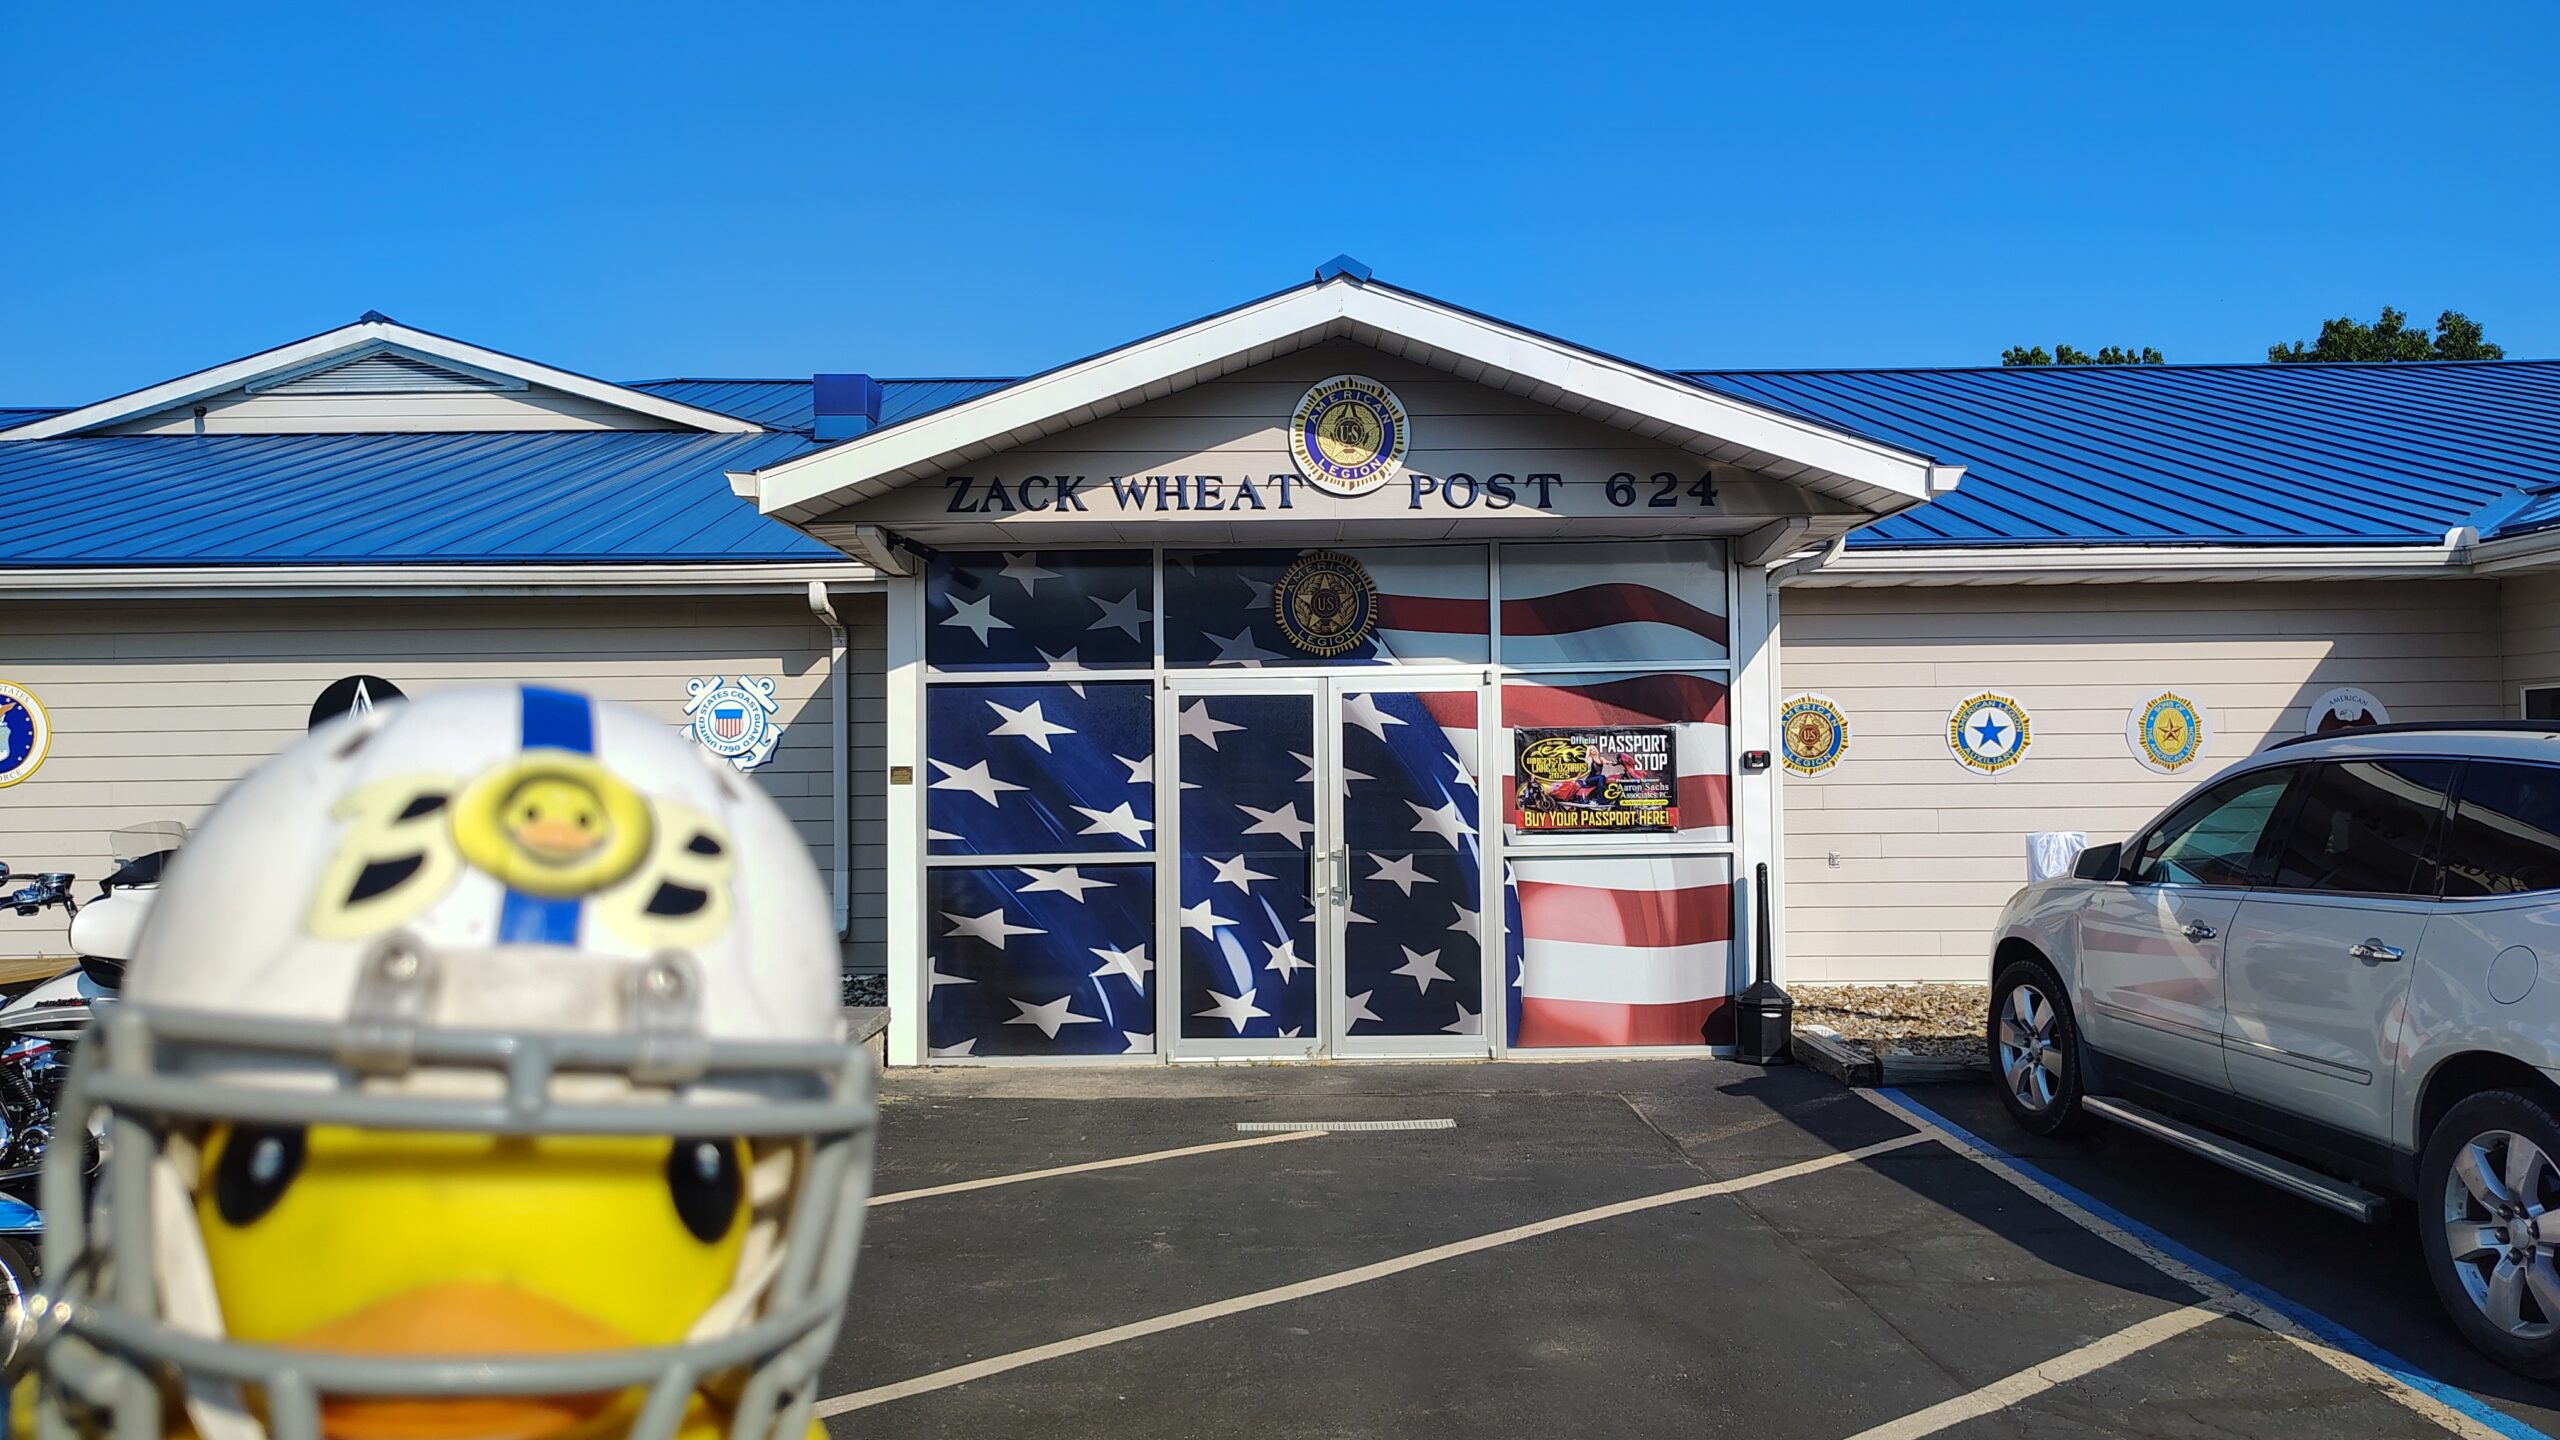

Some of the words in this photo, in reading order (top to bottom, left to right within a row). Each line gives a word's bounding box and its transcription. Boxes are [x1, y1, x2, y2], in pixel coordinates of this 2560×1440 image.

[1309, 390, 1391, 424] AMERICAN
[1318, 458, 1382, 479] LEGION
[944, 475, 1089, 513] ZACK
[1109, 474, 1304, 513] WHEAT
[1407, 472, 1563, 510] POST
[1605, 469, 1719, 508] 624
[1287, 562, 1365, 594] AMERICAN
[1298, 628, 1356, 646] LEGION
[0, 685, 31, 704] TATES
[700, 690, 729, 716] STATES
[731, 690, 759, 713] COAST
[2329, 694, 2369, 706] AMERICAN
[1781, 703, 1839, 727] AMERICAN
[1958, 700, 1996, 733] AMERICAN
[1998, 701, 2023, 733] LEGION
[699, 716, 718, 749] UNITED
[743, 713, 761, 747] GUARD
[718, 744, 741, 753] 1790
[1570, 735, 1598, 745] Official
[1599, 734, 1668, 753] PASSPORT
[1634, 753, 1668, 771] STOP
[1788, 752, 1832, 767] LEGION
[1963, 748, 2015, 765] AUXILIARY
[1617, 783, 1642, 791] Aaron
[1644, 782, 1669, 791] Sachs
[1524, 811, 1546, 827] BUY
[1550, 811, 1578, 827] YOUR
[1581, 810, 1637, 827] PASSPORT
[1639, 809, 1670, 826] HERE!
